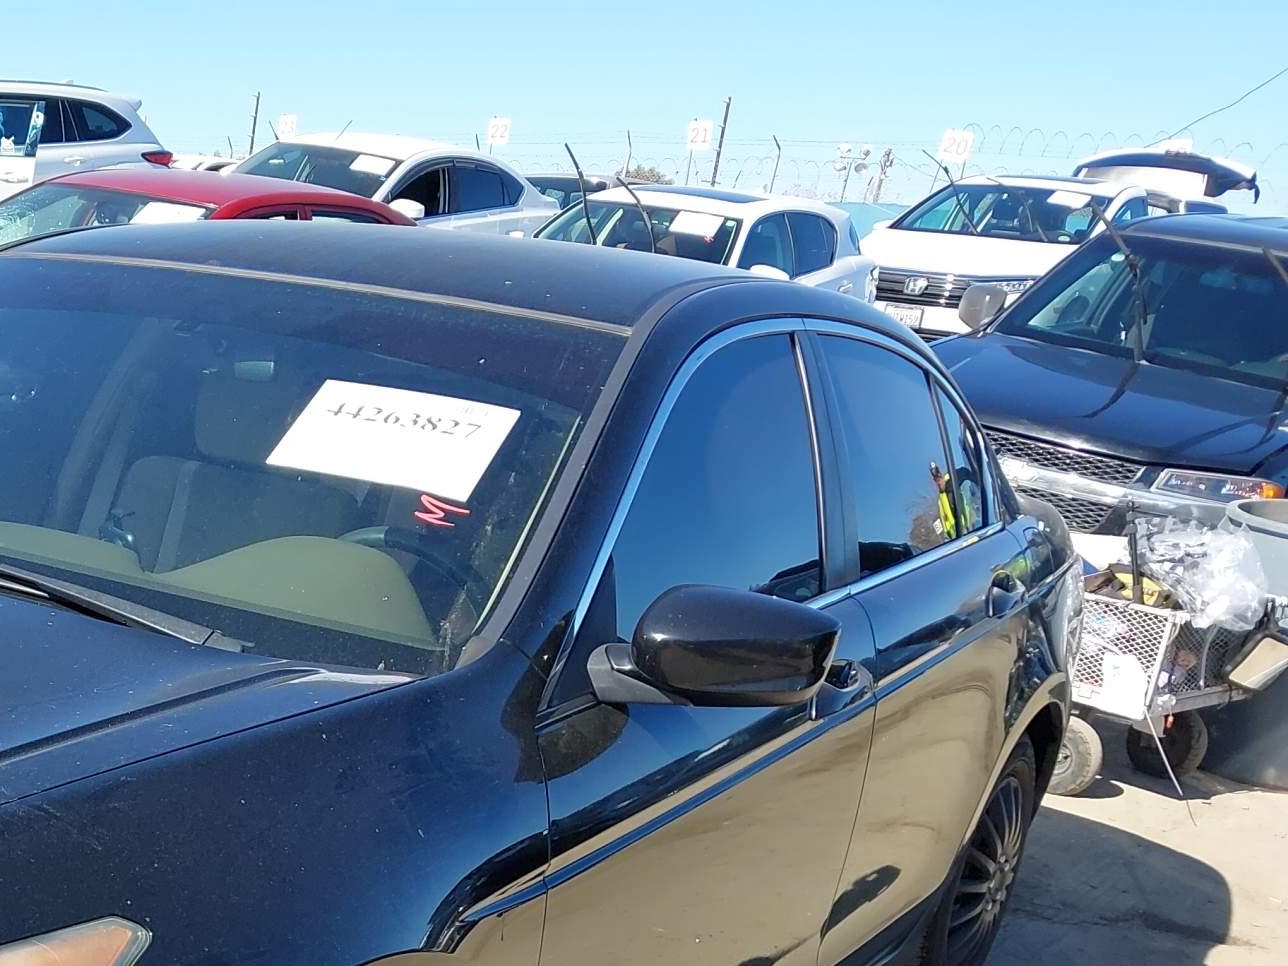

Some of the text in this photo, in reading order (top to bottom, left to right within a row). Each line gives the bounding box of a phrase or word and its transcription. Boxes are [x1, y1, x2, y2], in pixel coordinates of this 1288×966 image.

[490, 123, 509, 139] 22
[690, 127, 709, 144] 21
[943, 135, 969, 156] 20
[327, 401, 483, 438] 44263827
